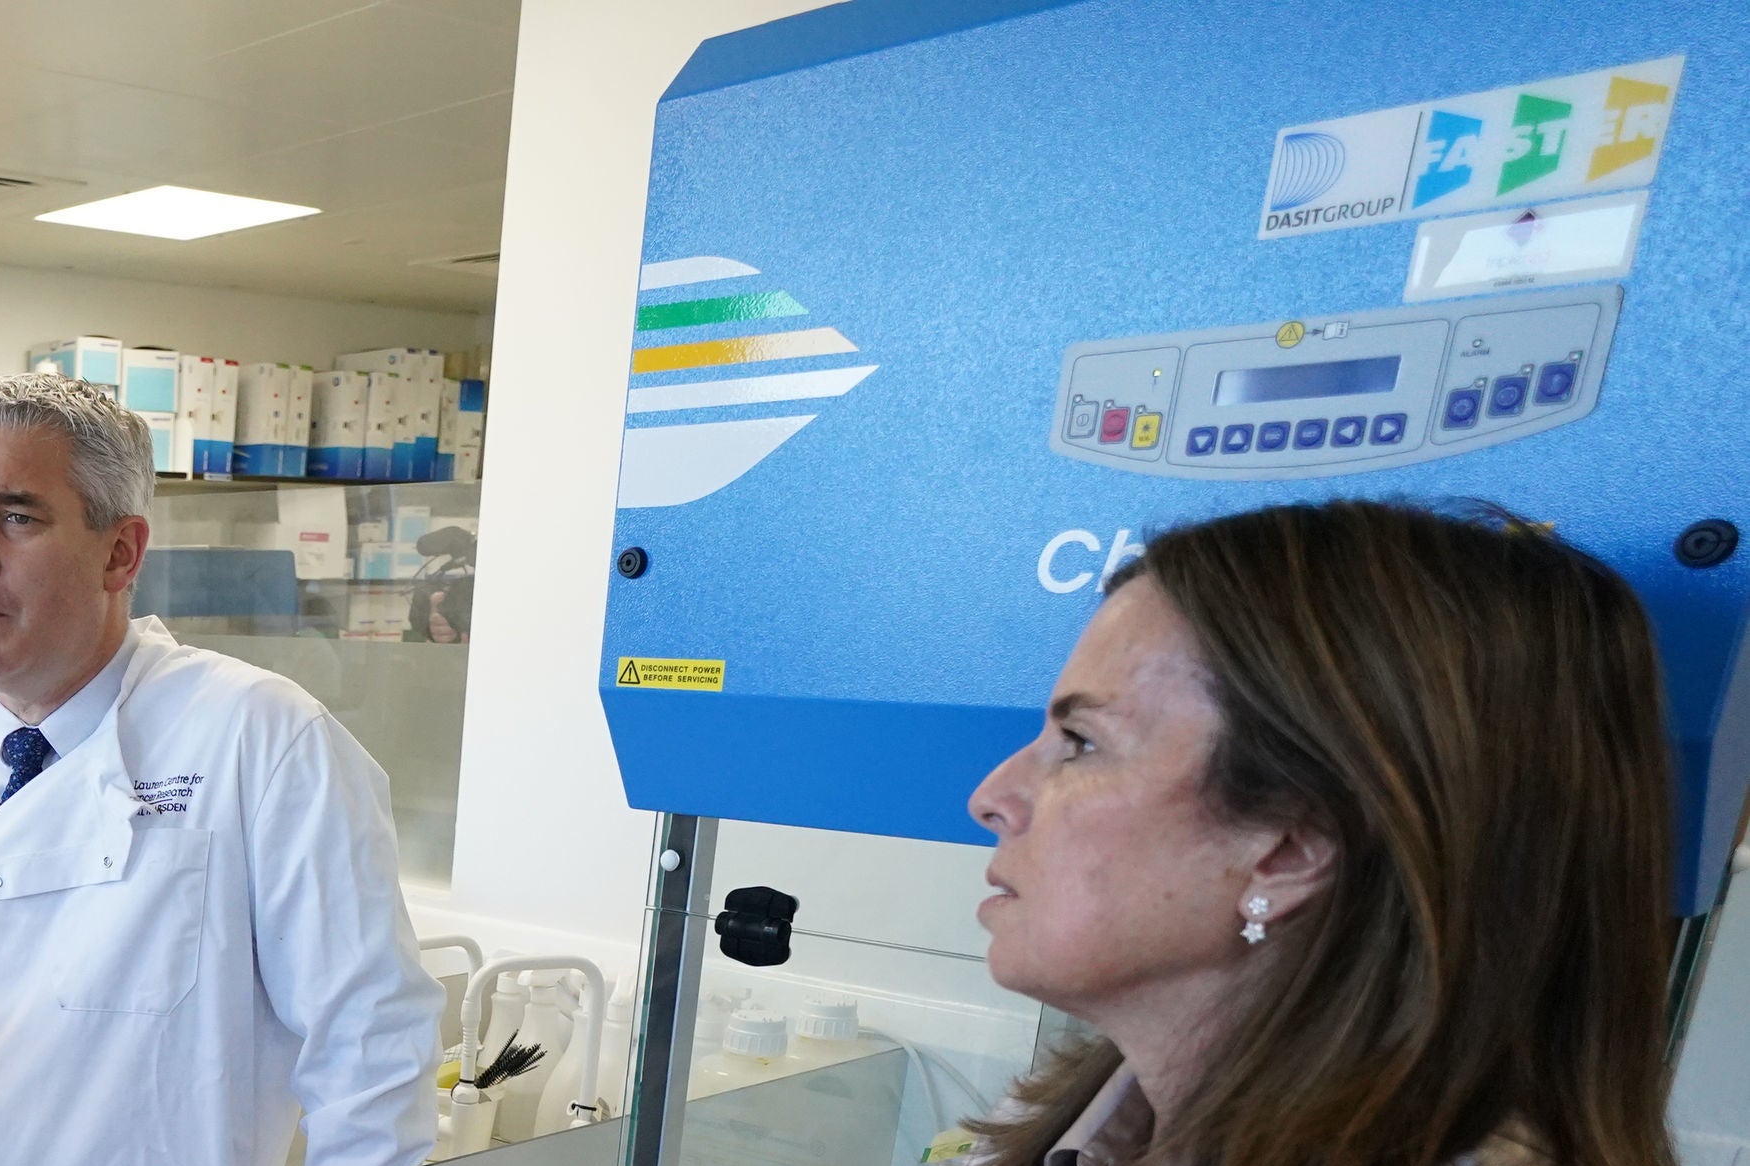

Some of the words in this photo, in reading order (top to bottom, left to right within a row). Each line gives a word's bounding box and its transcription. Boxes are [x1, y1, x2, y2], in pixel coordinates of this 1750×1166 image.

[1265, 197, 1395, 232] DASITGROUP
[641, 664, 688, 673] DISCONNECT
[692, 666, 721, 674] POWER
[643, 674, 672, 682] BEFORE
[677, 675, 718, 684] SERVICING
[134, 780, 163, 790] Lauren
[164, 775, 189, 787] Centre
[190, 773, 204, 785] for
